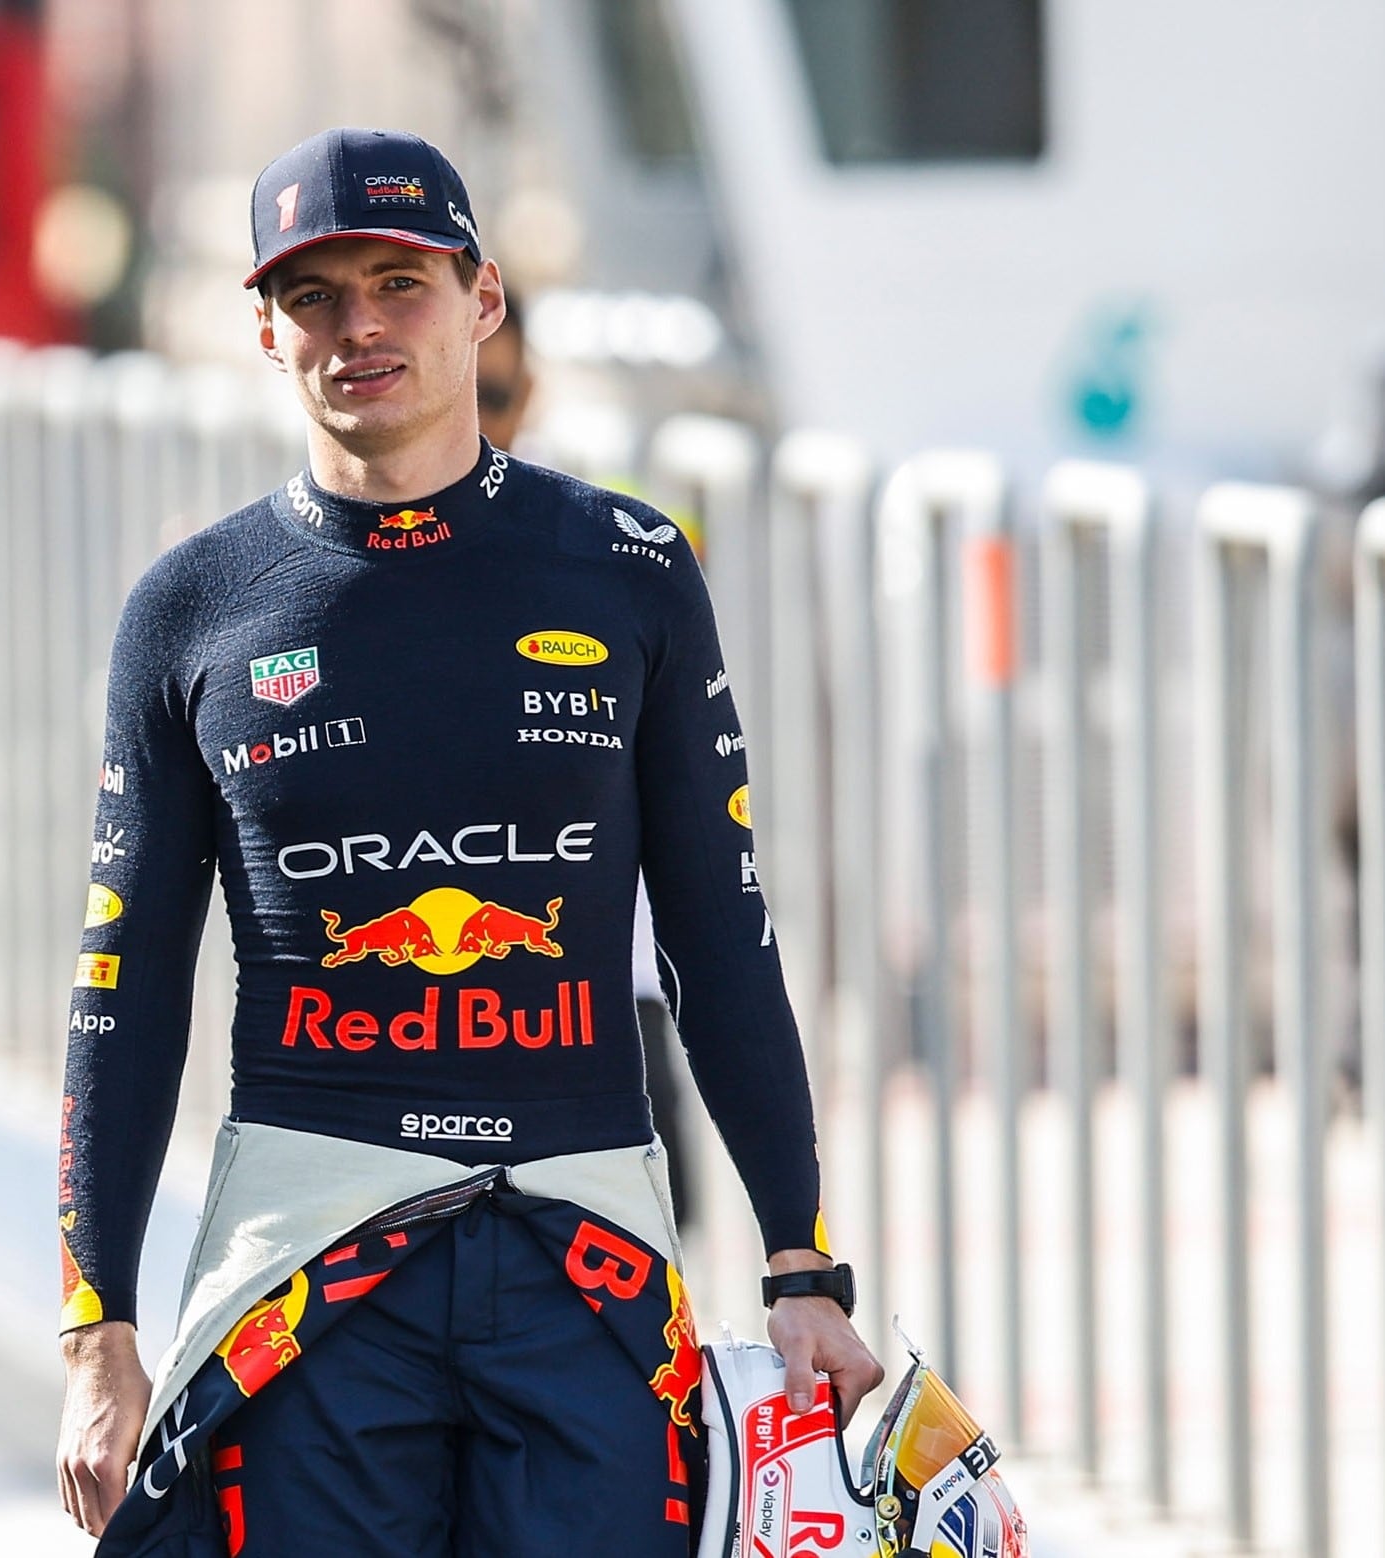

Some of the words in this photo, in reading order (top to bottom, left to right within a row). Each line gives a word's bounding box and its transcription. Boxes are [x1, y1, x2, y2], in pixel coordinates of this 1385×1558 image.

[365, 176, 422, 186] ORACLE
[276, 183, 300, 233] 1
[369, 197, 426, 205] RACING
[479, 447, 509, 499] zoo
[286, 470, 323, 528] oom
[366, 529, 408, 550] Red
[412, 522, 452, 548] Bull
[612, 542, 672, 569] CASTORE
[255, 651, 314, 677] TAG
[541, 640, 598, 658] RAUCH
[255, 671, 317, 703] HEUER
[523, 688, 617, 721] BYBIT
[221, 725, 319, 776] Mobil
[518, 728, 623, 750] HONDA
[277, 822, 598, 881] ORACLE
[71, 1010, 116, 1035] App
[281, 985, 440, 1051] Red
[458, 980, 594, 1050] Bull
[400, 1111, 513, 1141] sparco
[755, 1405, 775, 1450] BYBIT
[759, 1489, 776, 1538] viaplay
